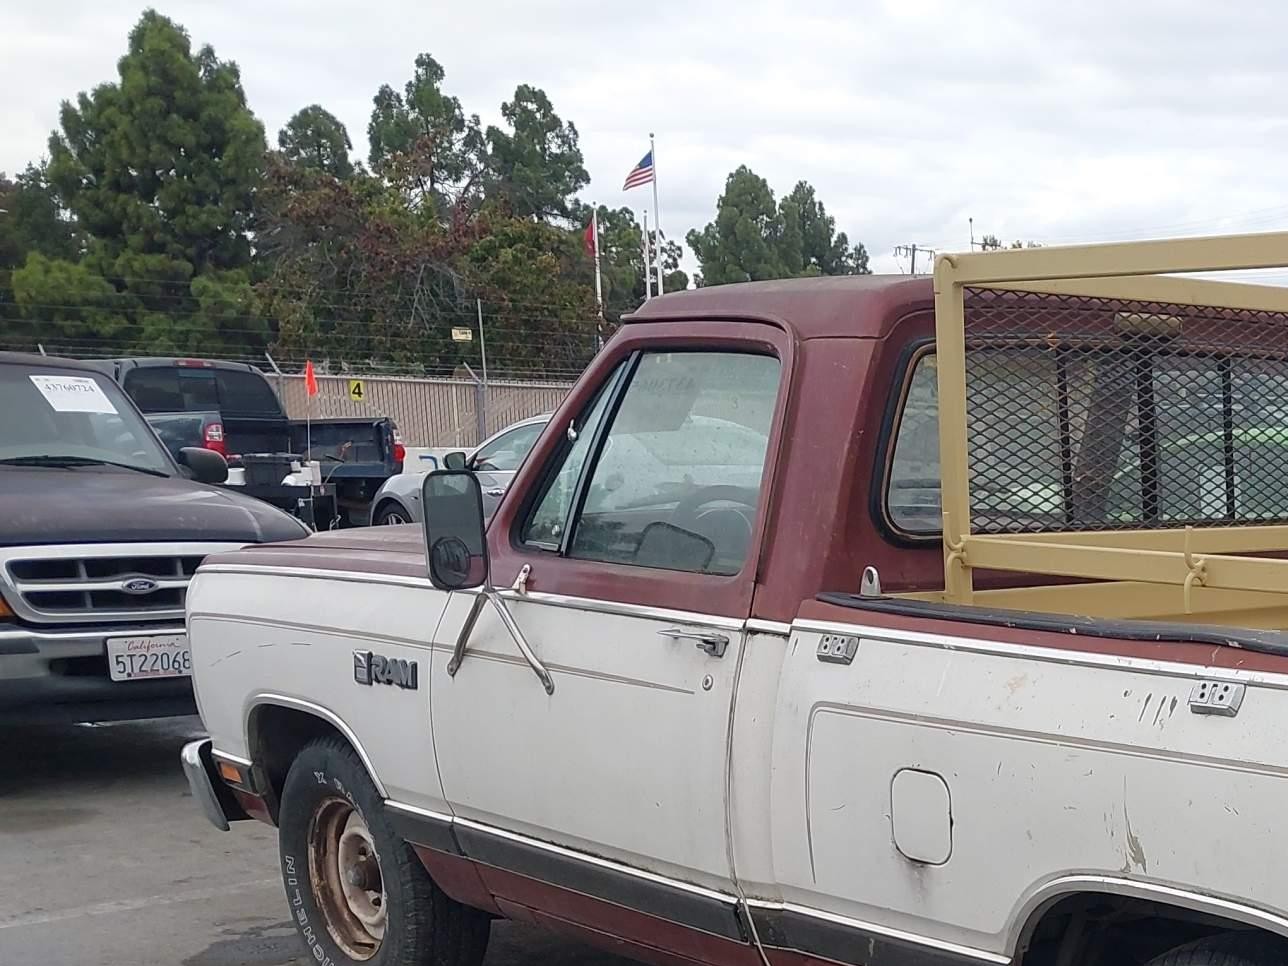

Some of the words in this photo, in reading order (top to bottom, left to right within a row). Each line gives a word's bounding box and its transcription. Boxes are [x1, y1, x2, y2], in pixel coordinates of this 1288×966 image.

[352, 382, 363, 398] 4
[131, 582, 150, 590] Ford
[128, 640, 181, 653] California
[371, 654, 418, 690] RAM
